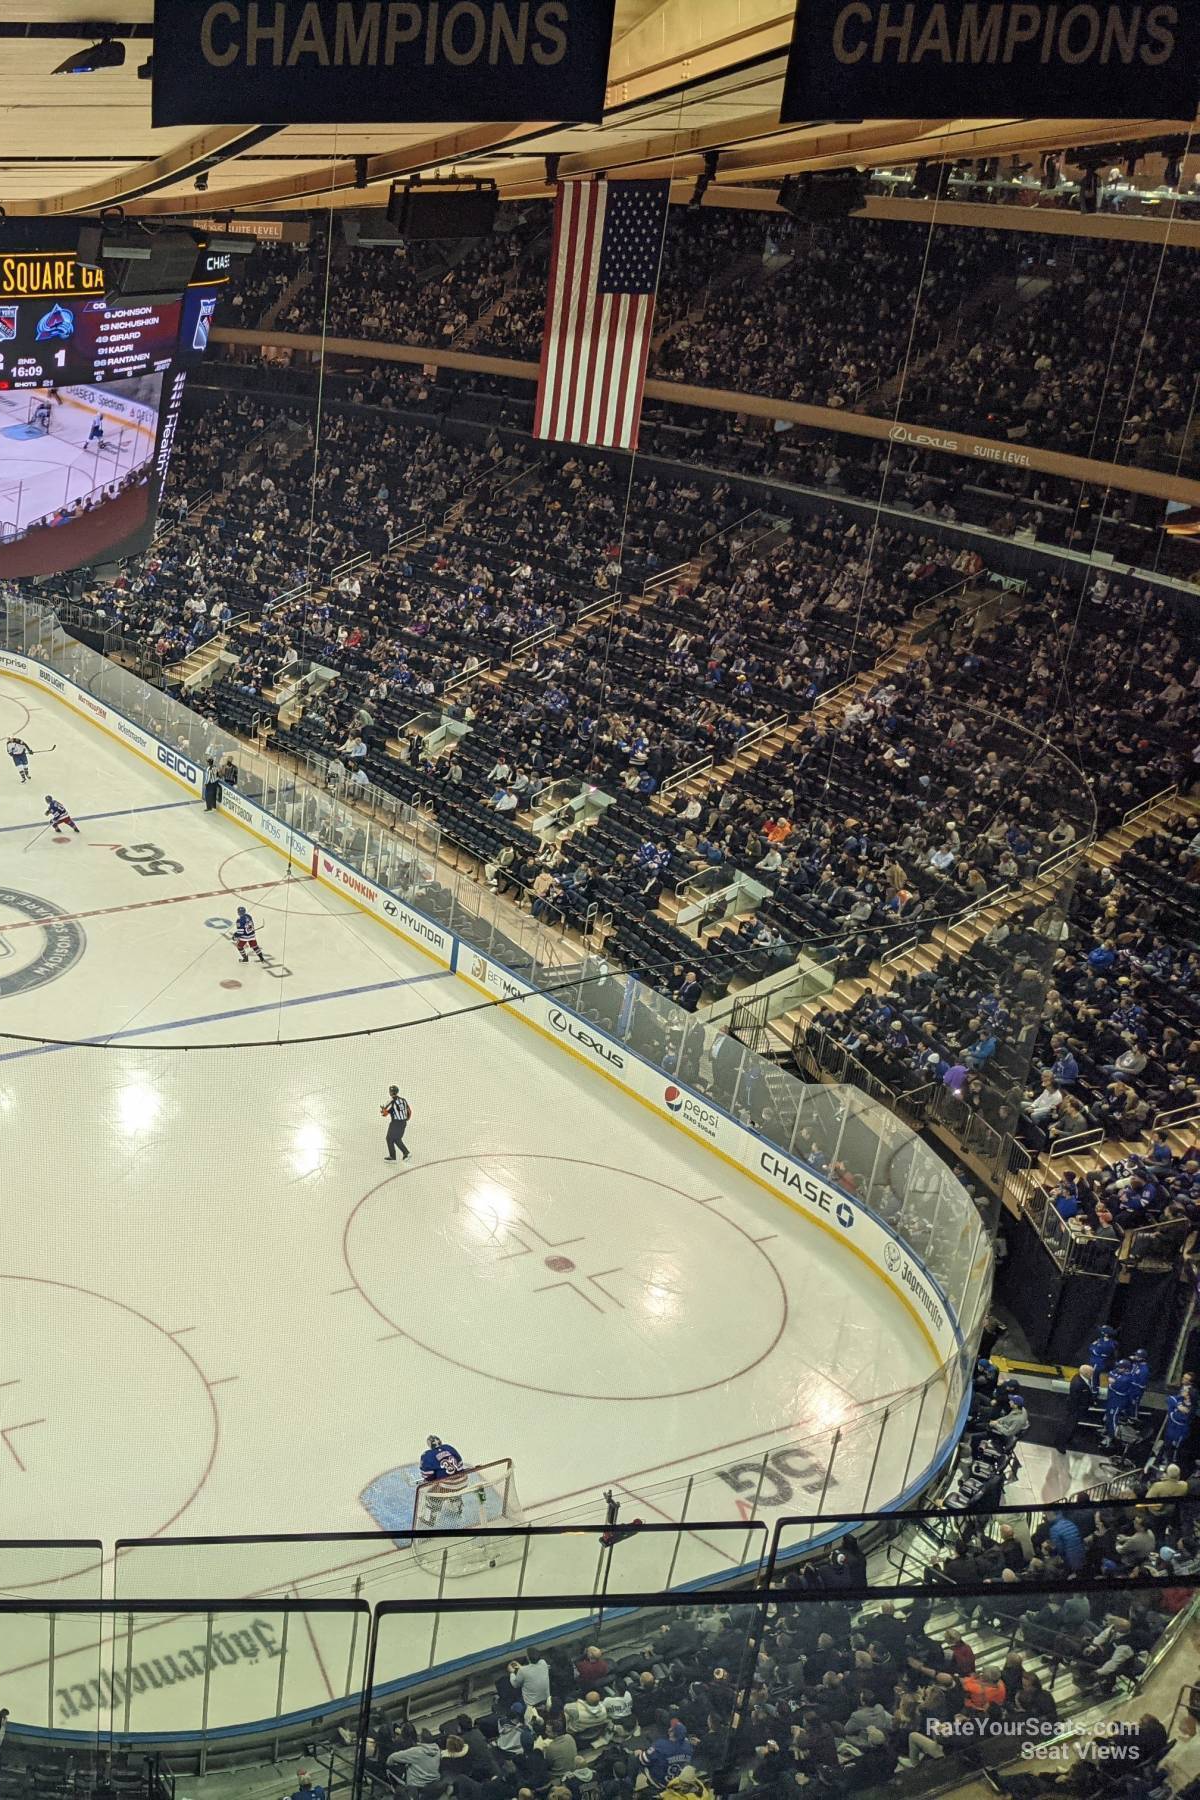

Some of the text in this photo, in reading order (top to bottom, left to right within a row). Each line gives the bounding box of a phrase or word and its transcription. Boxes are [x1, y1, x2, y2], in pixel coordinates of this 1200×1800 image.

[200, 1, 569, 66] CHAMPIONS
[832, 1, 1179, 66] CHAMPIONS
[253, 226, 279, 236] LEVEL
[2, 258, 76, 293] SQUARE
[110, 317, 160, 330] NICHUSHKIN
[112, 302, 152, 318] JOHNSON
[108, 344, 134, 354] KADRI
[110, 331, 141, 342] GIRARD
[11, 366, 43, 377] 16:09
[17, 358, 37, 366] 2ND
[54, 349, 67, 367] 1
[107, 352, 151, 366] RANTANEN
[156, 413, 178, 472] Health
[907, 433, 1032, 466] LEXUS SUITE LEVEL
[39, 666, 65, 692] BUD LIGHT
[117, 719, 147, 748] ticketmaster
[157, 745, 197, 784] GEICO
[223, 797, 253, 824] SPORTSBOOK
[261, 814, 281, 840] Infosys
[286, 831, 307, 856] Infosys
[115, 842, 185, 877] 5G
[342, 872, 378, 902] DUNKIN'
[400, 910, 445, 949] HYUNDAI
[33, 935, 72, 976] MADISON
[568, 1024, 624, 1069] LEXUS
[682, 1111, 716, 1138] ZERO SUGAR
[684, 1099, 719, 1129] pepsi
[760, 1151, 834, 1214] CHASE
[714, 1448, 840, 1507] 5G
